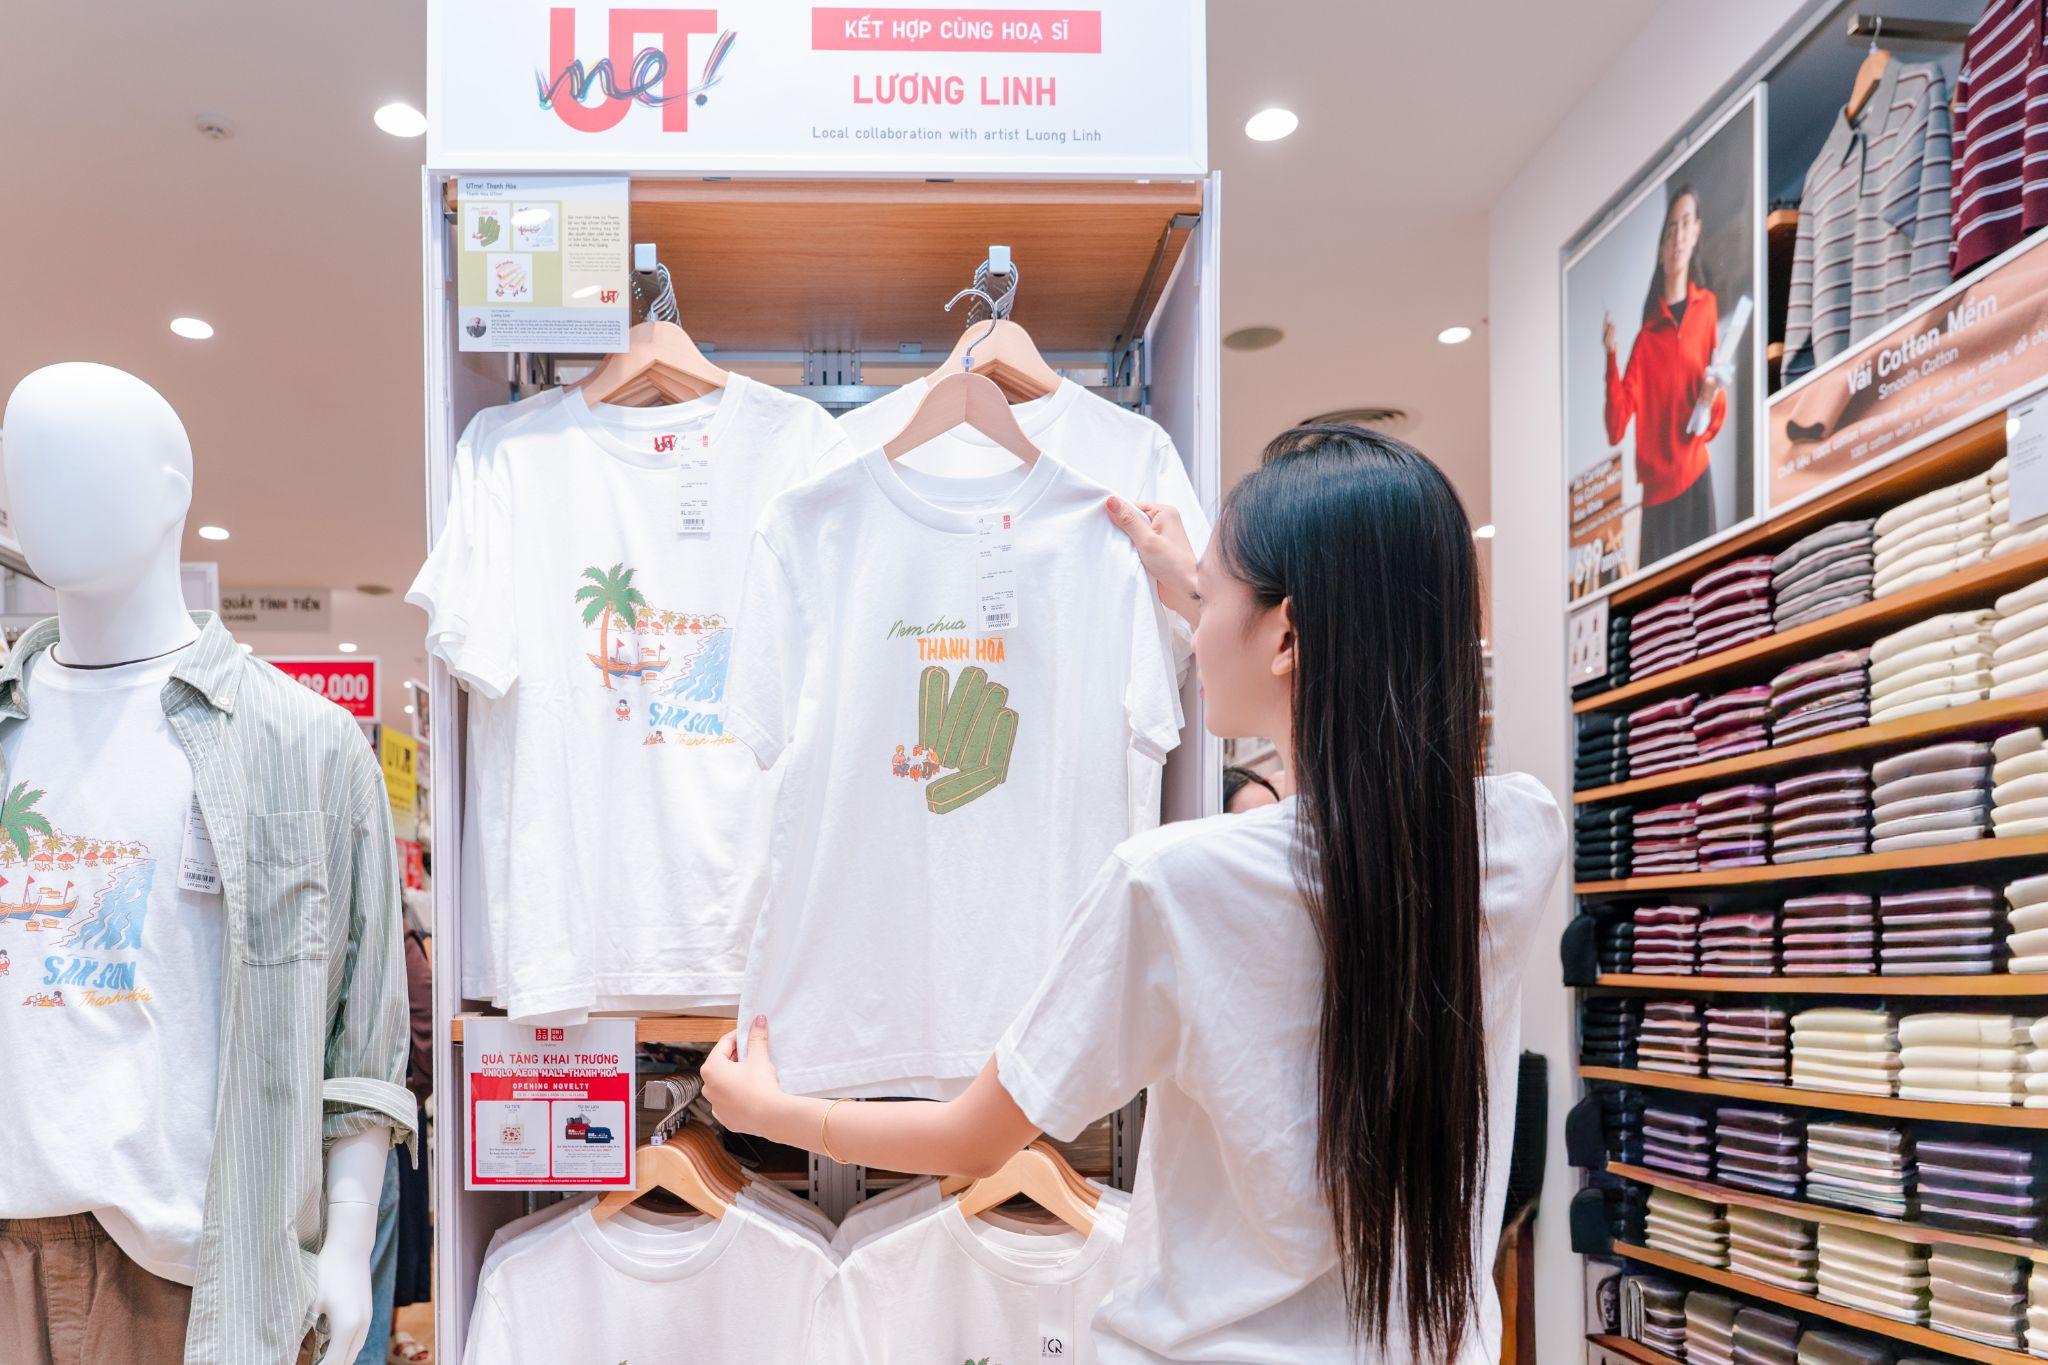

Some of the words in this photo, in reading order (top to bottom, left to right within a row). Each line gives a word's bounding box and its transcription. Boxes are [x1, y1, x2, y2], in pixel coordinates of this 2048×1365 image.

[845, 15, 884, 39] KẾT
[893, 19, 931, 42] HỢP
[940, 17, 993, 39] CÙNG
[1002, 22, 1042, 44] HOẠ
[1052, 19, 1069, 40] SĨ
[550, 8, 717, 132] UT
[853, 72, 965, 105] LƯƠNG
[981, 76, 1056, 106] LINH
[812, 126, 849, 139] Local
[855, 127, 942, 140] collaboration
[949, 128, 977, 140] with
[984, 128, 1020, 141] artist
[1026, 129, 1066, 143] Luong
[1073, 129, 1101, 141] Linh
[1877, 328, 1940, 377] Cotton
[1878, 367, 1919, 400] Smooth
[1921, 347, 1959, 376] Cotton
[887, 619, 925, 640] Nem
[926, 615, 967, 633] chua
[917, 638, 971, 661] THANH
[482, 1052, 504, 1065] QUÀ
[509, 1051, 539, 1067] TẶNG
[543, 1054, 569, 1064] KHAI
[574, 1053, 619, 1064] TRƯƠNG
[482, 1068, 513, 1078] UNIQLO
[515, 1068, 539, 1077] AEON
[541, 1068, 566, 1077] MALL
[568, 1068, 598, 1077] THANH
